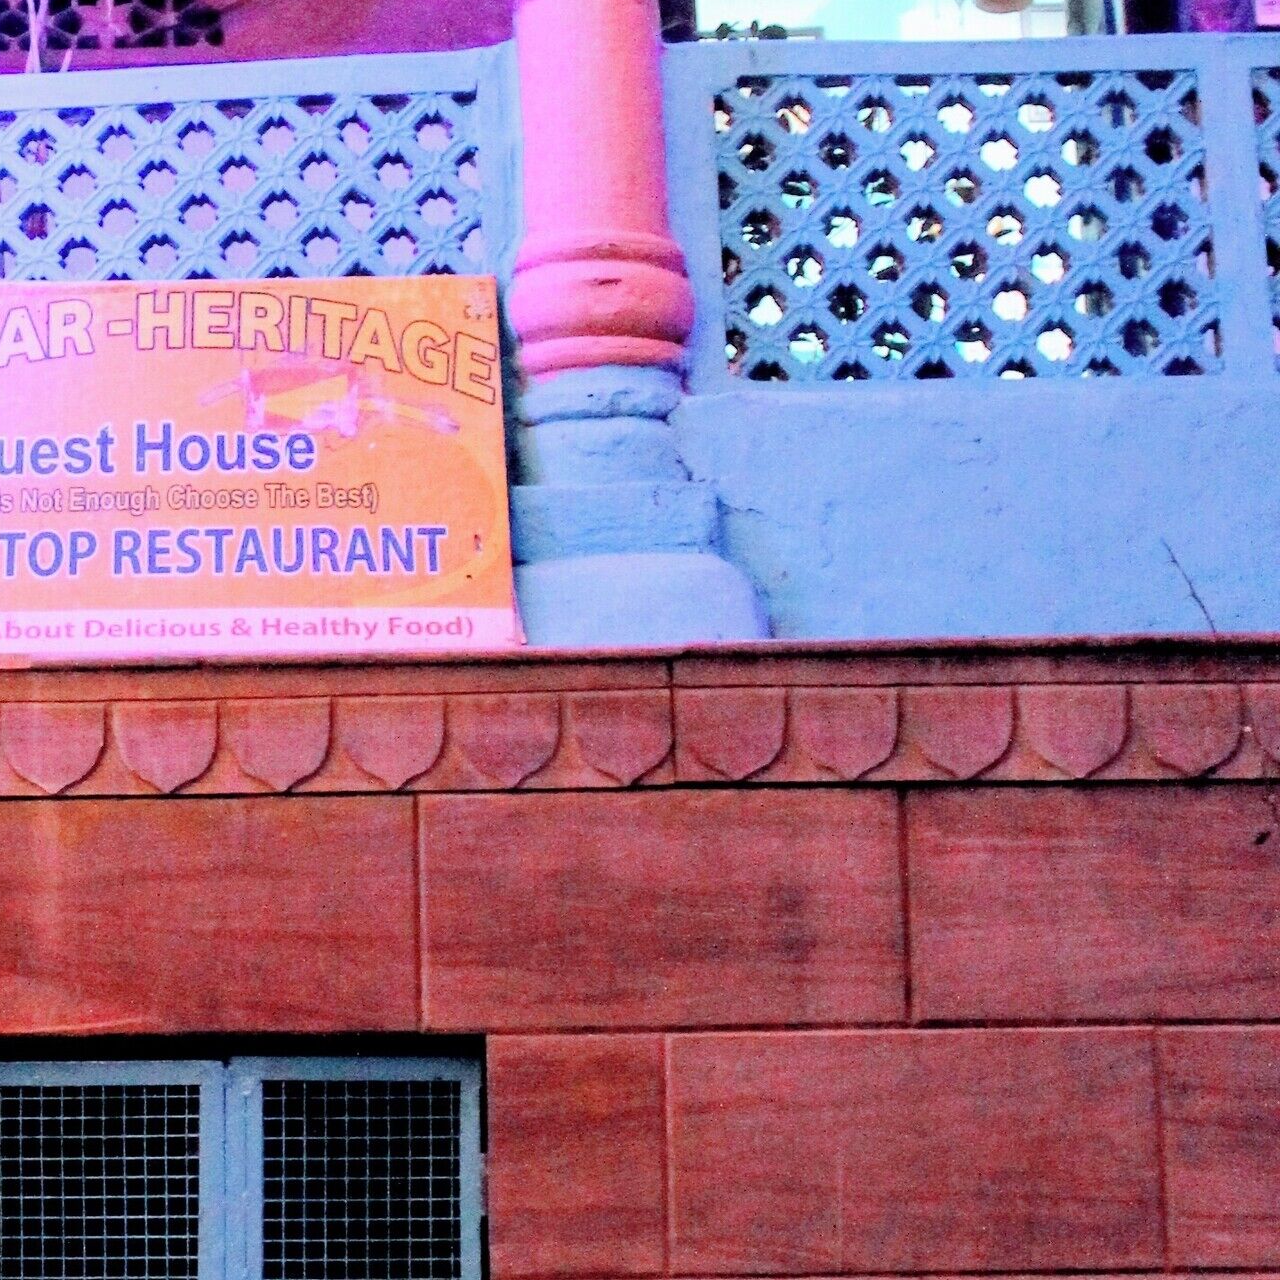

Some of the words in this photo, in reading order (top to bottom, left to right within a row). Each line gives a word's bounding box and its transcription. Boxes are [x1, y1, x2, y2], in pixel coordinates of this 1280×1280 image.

[135, 422, 315, 472] House
[20, 487, 63, 513] Not
[69, 485, 160, 516] Enough
[167, 484, 259, 510] Choose
[264, 482, 310, 509] The
[316, 482, 379, 514] Best)
[113, 527, 447, 575] RESTAURANT
[84, 617, 222, 639] Delicious
[229, 618, 252, 637] &
[261, 617, 380, 641] Healthy
[388, 616, 475, 640] Food)
